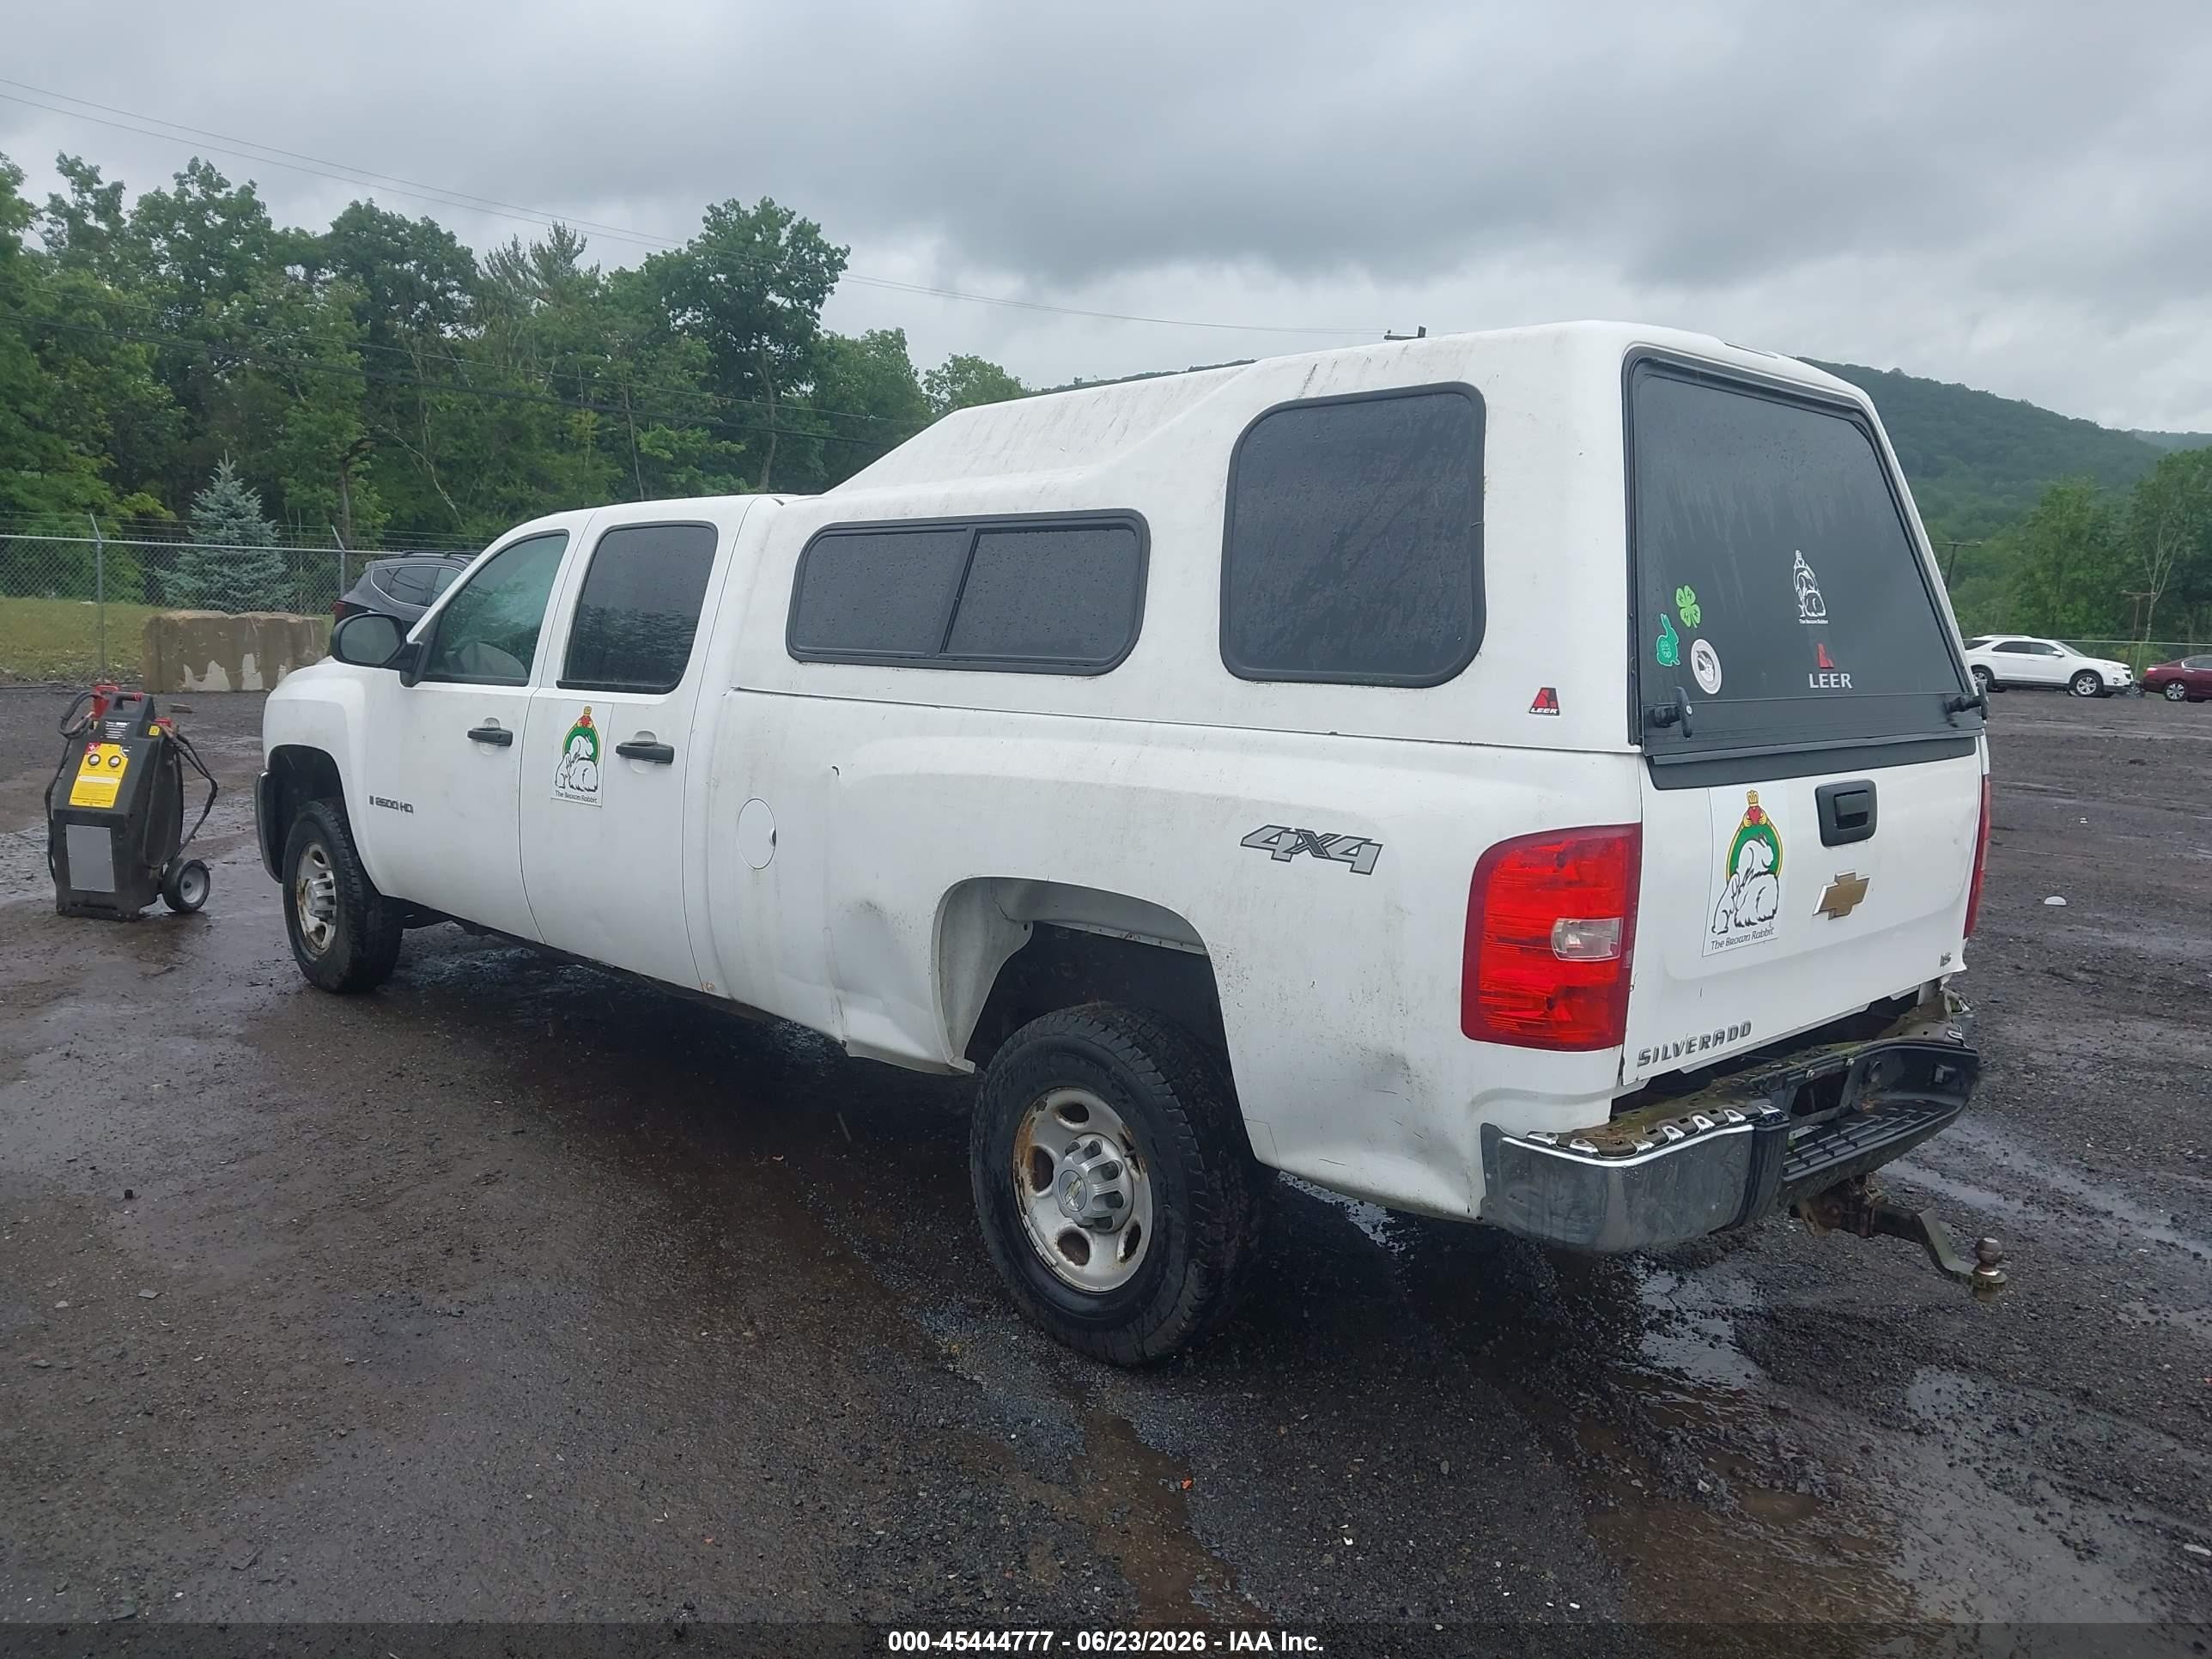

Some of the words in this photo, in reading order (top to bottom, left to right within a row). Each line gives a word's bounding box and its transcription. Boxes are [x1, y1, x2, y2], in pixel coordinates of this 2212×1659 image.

[1808, 672, 1853, 689] LEER
[1711, 940, 1724, 950] The
[1752, 927, 1774, 939] Rabbit
[1636, 1020, 1752, 1067] SILVERADO
